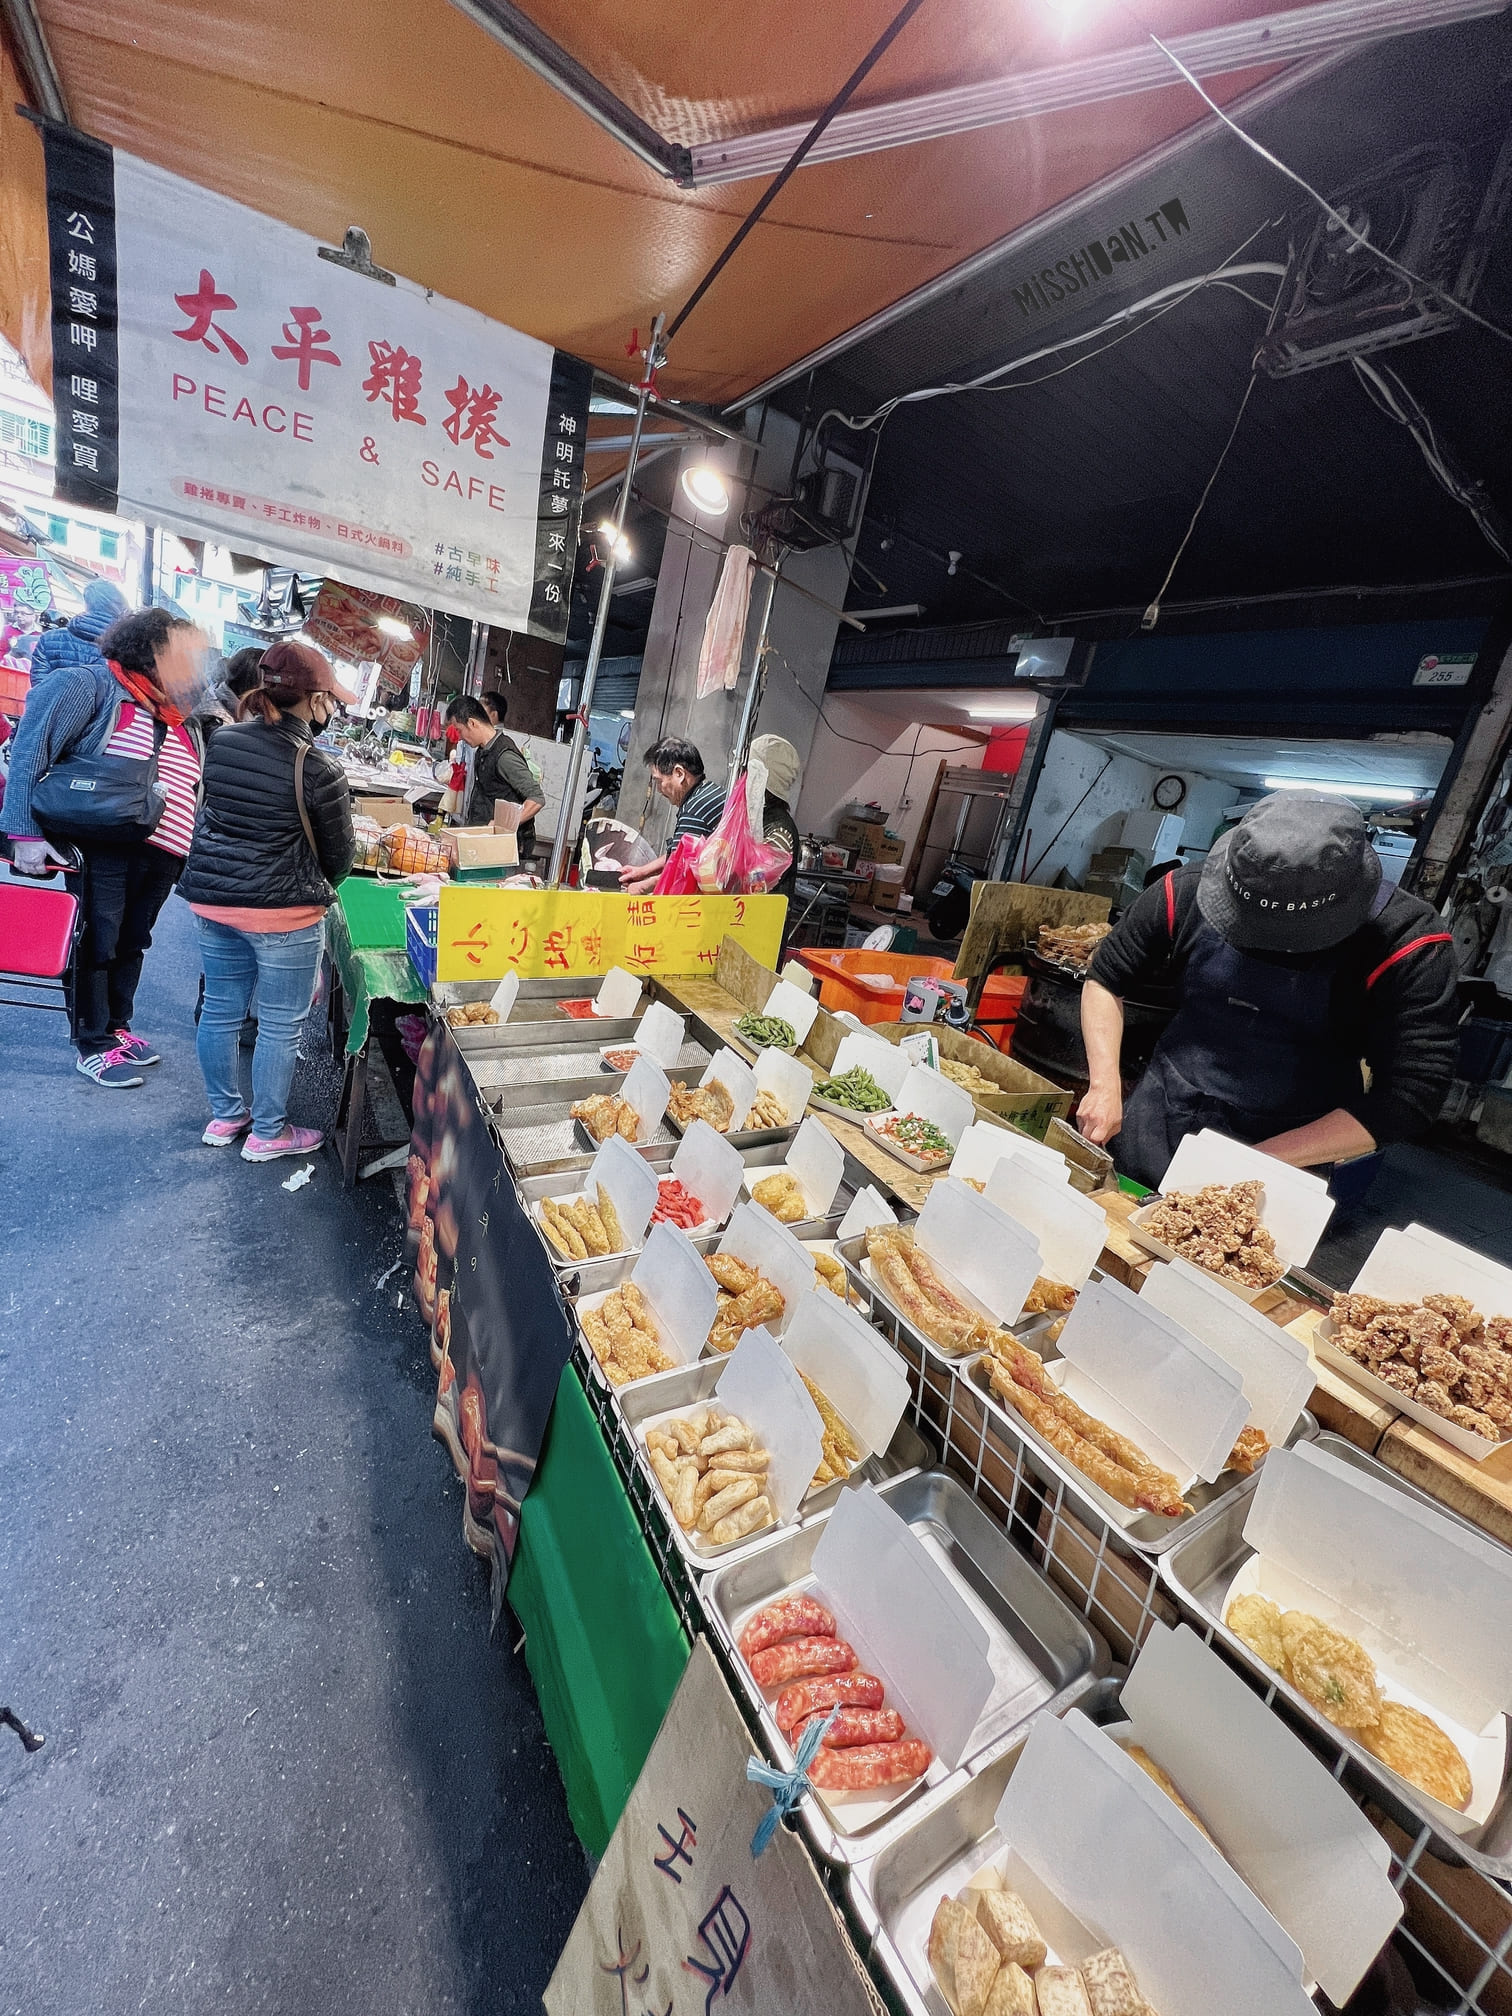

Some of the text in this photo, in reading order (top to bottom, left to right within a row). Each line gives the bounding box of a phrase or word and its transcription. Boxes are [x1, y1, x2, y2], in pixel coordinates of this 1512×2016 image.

[67, 210, 99, 473] 公媽愛呷 哩愛買
[171, 268, 512, 460] 太平雞捲
[172, 373, 506, 512] PEACE & SAFE
[544, 413, 577, 604] 神明託夢 來一份
[433, 561, 499, 594] #純手工
[434, 542, 501, 575] #古早味
[1428, 671, 1455, 683] 255
[1260, 898, 1280, 910] OF
[1286, 892, 1337, 912] BASIC
